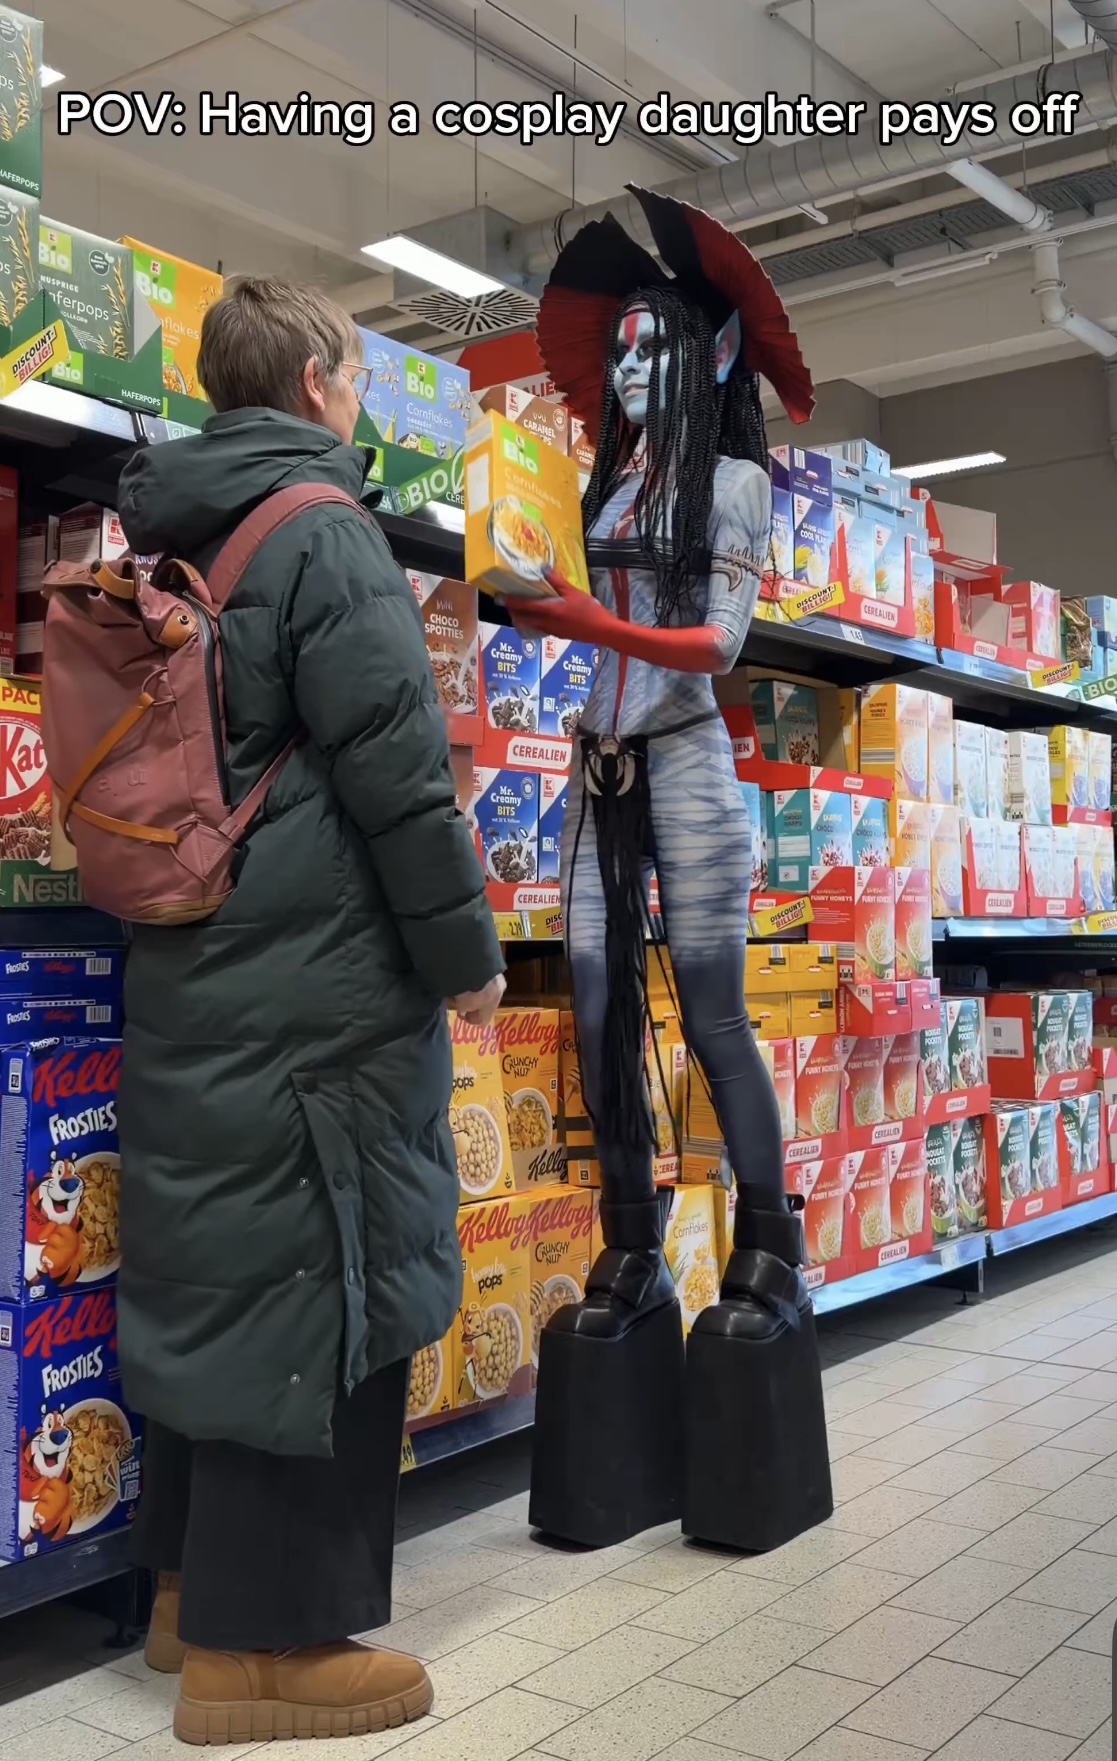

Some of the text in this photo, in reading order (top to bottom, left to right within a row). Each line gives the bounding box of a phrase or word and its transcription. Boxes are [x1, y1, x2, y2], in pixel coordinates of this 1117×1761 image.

[135, 270, 173, 305] Bio
[18, 343, 53, 383] BILLIG!
[406, 371, 436, 400] Bio
[121, 389, 162, 407] HAFERPOPS
[406, 402, 454, 429] Cornflakes
[523, 418, 557, 438] CARAMEL
[407, 469, 449, 508] BIO
[430, 613, 459, 628] CHOCO
[864, 604, 896, 621] CEREALIEN
[424, 623, 464, 640] SPOTTIES
[499, 642, 515, 653] Mr.
[490, 648, 523, 667] Creamy
[571, 655, 585, 666] Mr.
[497, 661, 517, 673] BITS
[563, 660, 592, 675] Creamy
[569, 673, 586, 685] BITS
[512, 744, 568, 763] CEREALIEN
[499, 786, 515, 796] Mr.
[490, 794, 522, 806] Creamy
[497, 805, 516, 816] BITS
[775, 910, 803, 930] BILLIG!
[5, 961, 30, 974] FROSTIES
[7, 1010, 31, 1024] FROSTIES
[502, 1054, 539, 1075] CRUNCHY
[513, 1067, 531, 1078] NUT
[805, 1065, 821, 1075] FUNNY
[48, 1100, 118, 1145] FROSTIES
[874, 1127, 900, 1139] CEREALIEN
[788, 1145, 820, 1158] CEREALIEN
[673, 1221, 709, 1240] Cornflakes
[535, 1241, 570, 1263] CRUNCHY
[545, 1253, 562, 1267] NUT
[880, 1245, 907, 1261] CEREALIEN
[478, 1273, 503, 1294] pops
[41, 1344, 104, 1398] FROSTIES
